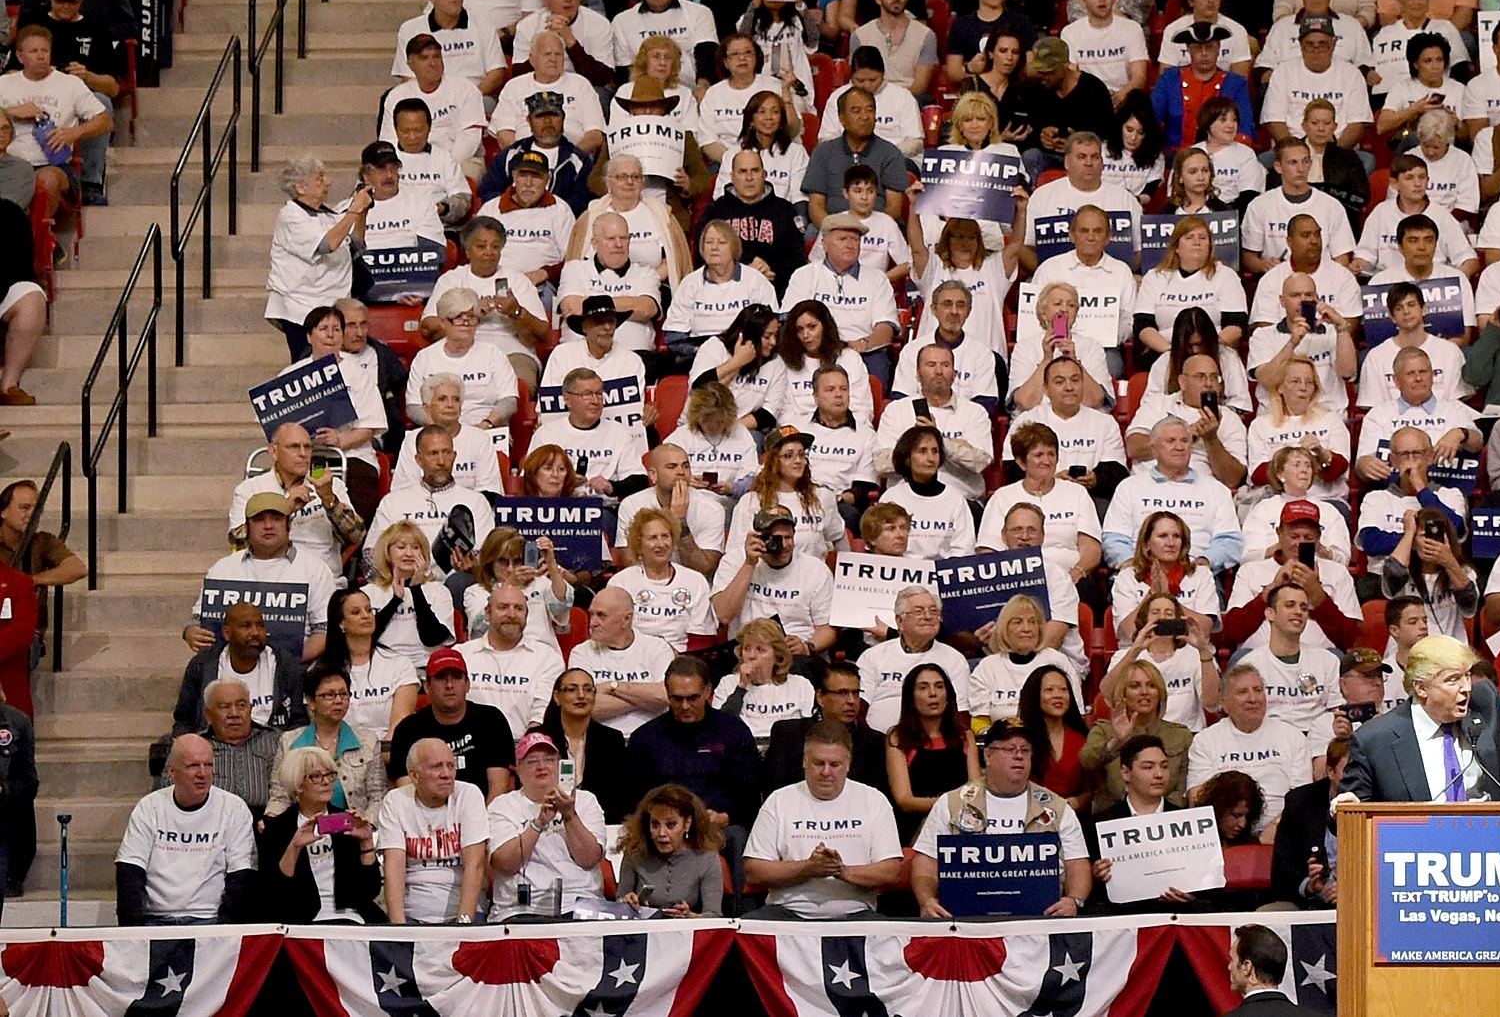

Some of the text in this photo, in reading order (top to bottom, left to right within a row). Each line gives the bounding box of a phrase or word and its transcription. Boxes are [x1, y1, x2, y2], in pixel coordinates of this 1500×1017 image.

[639, 27, 687, 38] TRUMP
[1292, 90, 1344, 101] TRUMP
[609, 124, 683, 144] TRUMP
[924, 158, 1019, 179] TRUMP
[940, 179, 970, 187] AMERICA
[972, 182, 992, 190] GREAT
[1035, 219, 1130, 236] TRP
[392, 266, 412, 274] GREAT
[1023, 293, 1117, 307] TMP
[1362, 286, 1460, 307] TMP
[253, 363, 339, 412] TRUMP
[541, 386, 638, 410] TMP
[261, 410, 278, 424] MAKE
[278, 400, 304, 418] AMERICA
[305, 392, 323, 406] GREAT
[1391, 417, 1446, 428] TRUMP
[1269, 428, 1328, 443] TRUMP
[1141, 498, 1205, 509] TRUMP
[497, 507, 601, 523] TRUMP
[937, 557, 1042, 585] TRUMP
[859, 586, 890, 595] AMERICA
[941, 590, 961, 599] MAKE
[962, 584, 994, 597] AMERICA
[996, 581, 1018, 591] GREAT
[204, 589, 307, 609] TRUMP
[470, 672, 530, 686] TRUMP
[592, 670, 650, 681] TRUMP
[792, 819, 862, 830] TRUMP
[157, 829, 220, 844] TRUMP
[1101, 817, 1214, 849] TRUMP
[939, 843, 1058, 864] TRUMP
[1128, 848, 1163, 861] AMERICA
[1166, 846, 1189, 856] GREAT
[1191, 841, 1218, 852] AGAIN!
[940, 868, 1059, 879] MAKE AMERICA GREAT AGAIN!
[1391, 891, 1423, 903] TEXT
[1424, 890, 1487, 903] "TRUMP"
[1487, 892, 1500, 903] to
[1399, 909, 1427, 922] Las
[1430, 909, 1481, 925] Vegas,
[1391, 951, 1423, 960] MAKE
[1425, 951, 1474, 960] AMERICA
